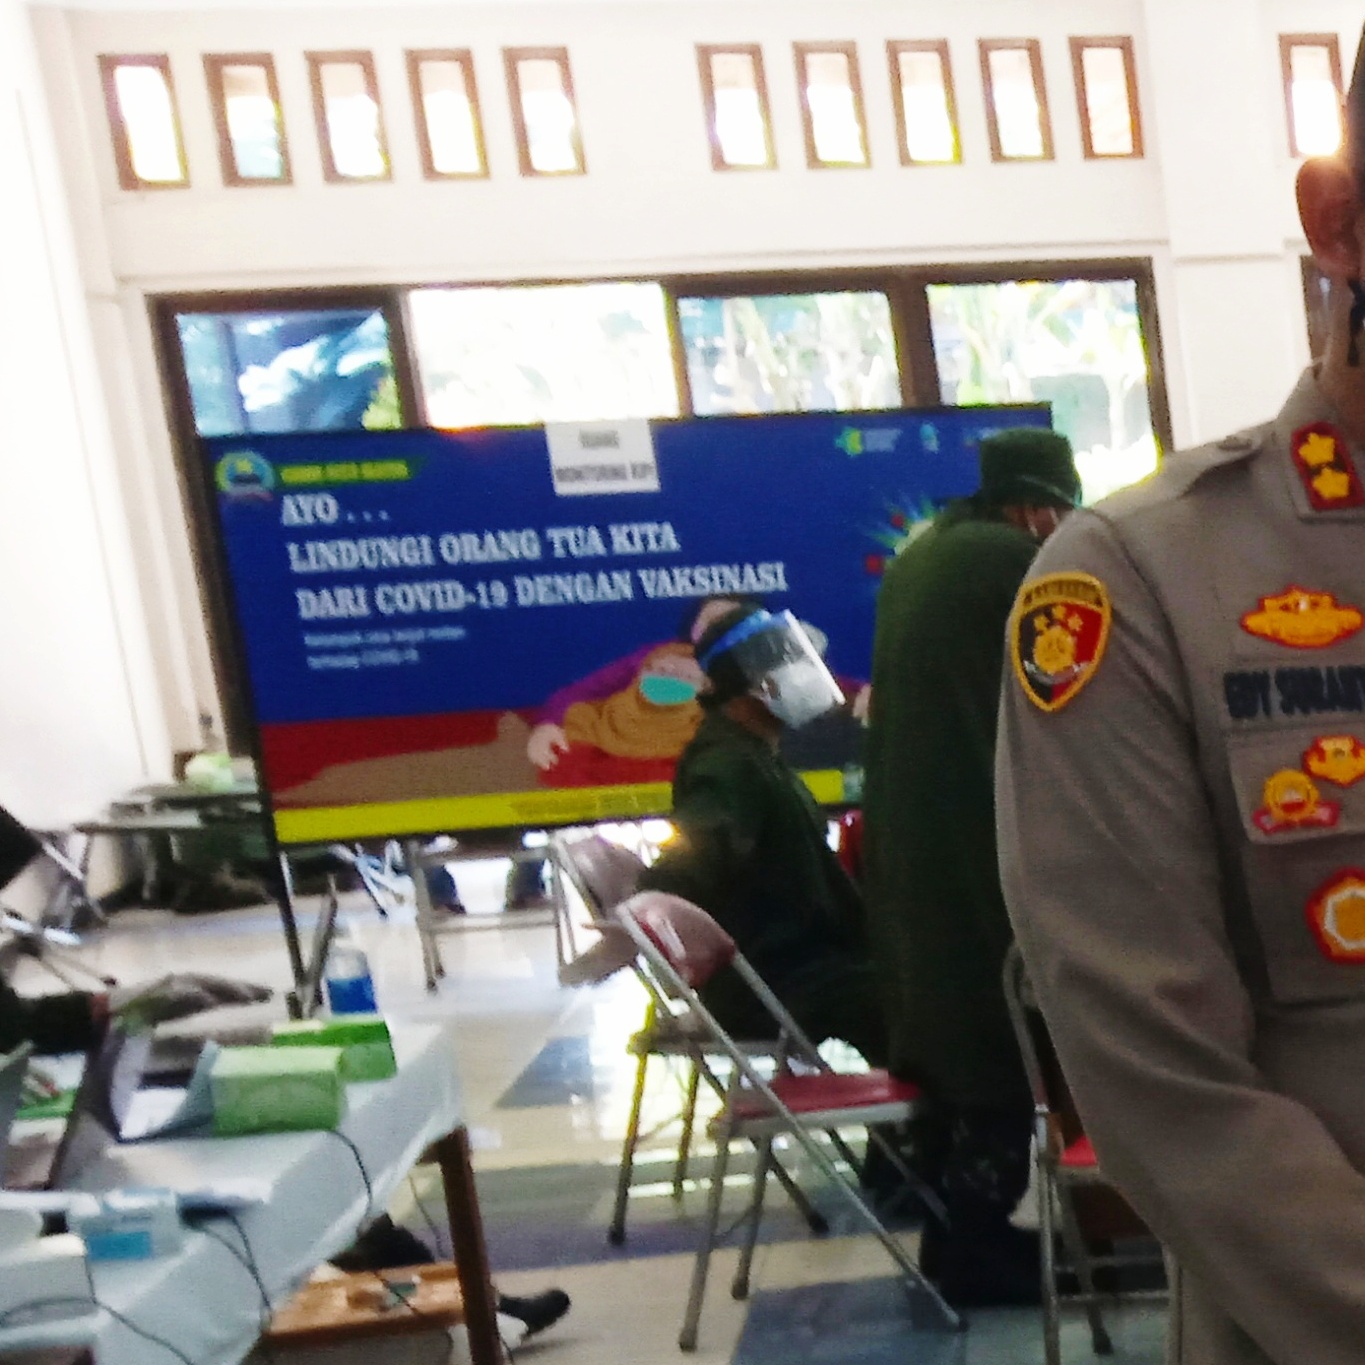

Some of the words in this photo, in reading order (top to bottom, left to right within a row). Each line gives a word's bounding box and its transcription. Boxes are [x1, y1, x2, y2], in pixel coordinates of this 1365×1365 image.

[287, 534, 435, 573] LINDUNGI
[439, 528, 542, 565] ORANG
[546, 524, 607, 558] TUA
[608, 520, 681, 554] KITA
[295, 585, 371, 619] DARI
[374, 578, 509, 615] COVID-19
[514, 570, 634, 606] DENGAN
[636, 560, 789, 598] VAKSINASI
